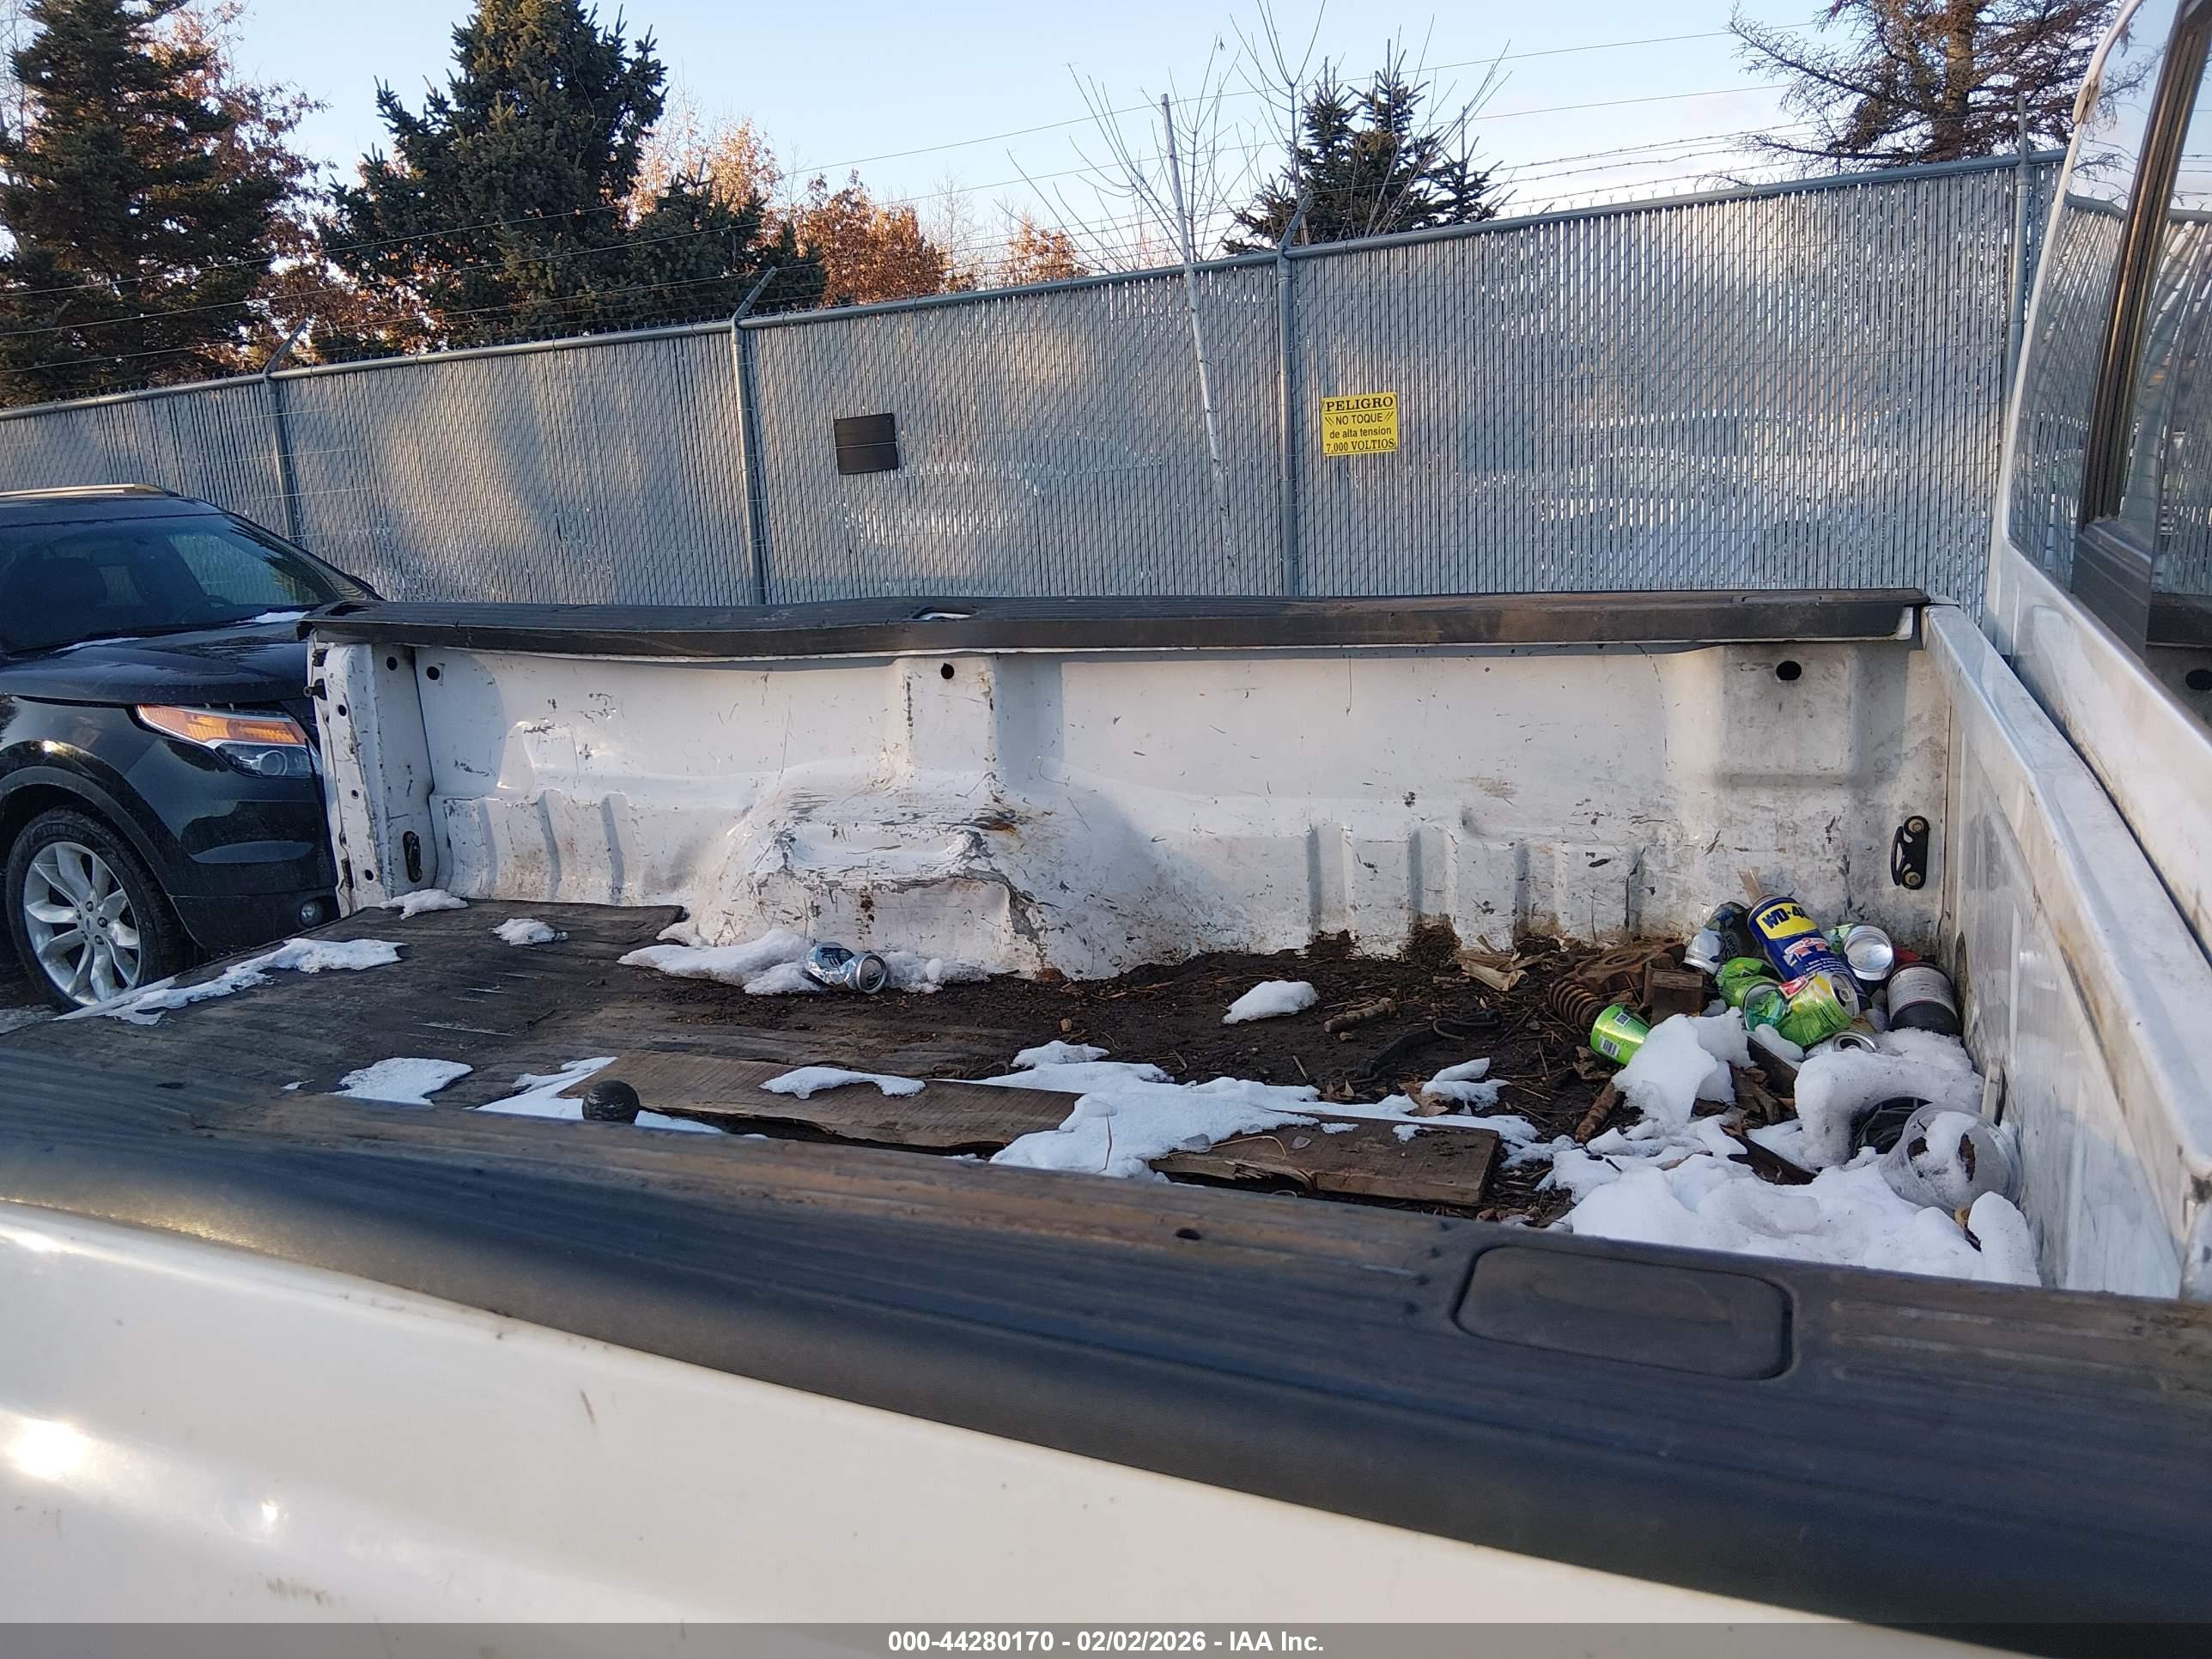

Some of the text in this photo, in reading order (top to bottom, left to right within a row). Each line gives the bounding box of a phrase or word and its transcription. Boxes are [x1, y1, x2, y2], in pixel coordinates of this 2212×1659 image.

[1325, 396, 1394, 411] PELIGRO
[1335, 412, 1383, 425] NO TOQUE
[1329, 426, 1392, 439] de alta tension
[1351, 438, 1395, 450] VOLTIOS
